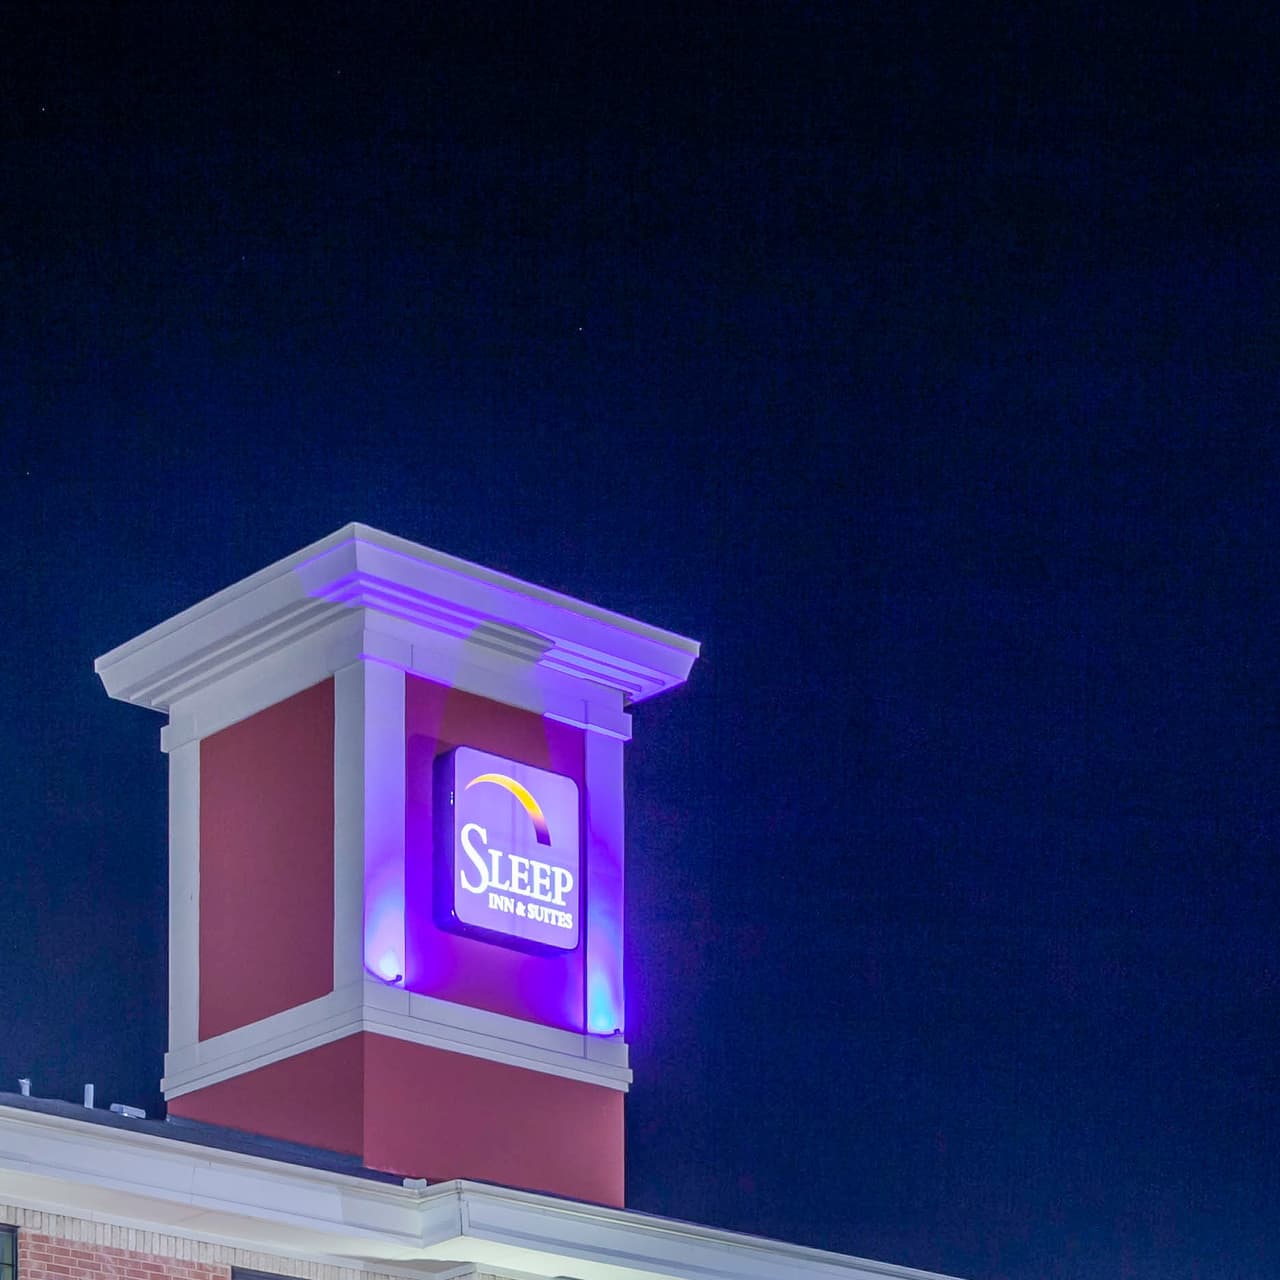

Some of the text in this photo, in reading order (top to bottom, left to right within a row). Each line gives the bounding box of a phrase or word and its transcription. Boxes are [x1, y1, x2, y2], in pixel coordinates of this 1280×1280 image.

[460, 823, 574, 907] SLEEP
[488, 892, 573, 930] INN & SUITES
